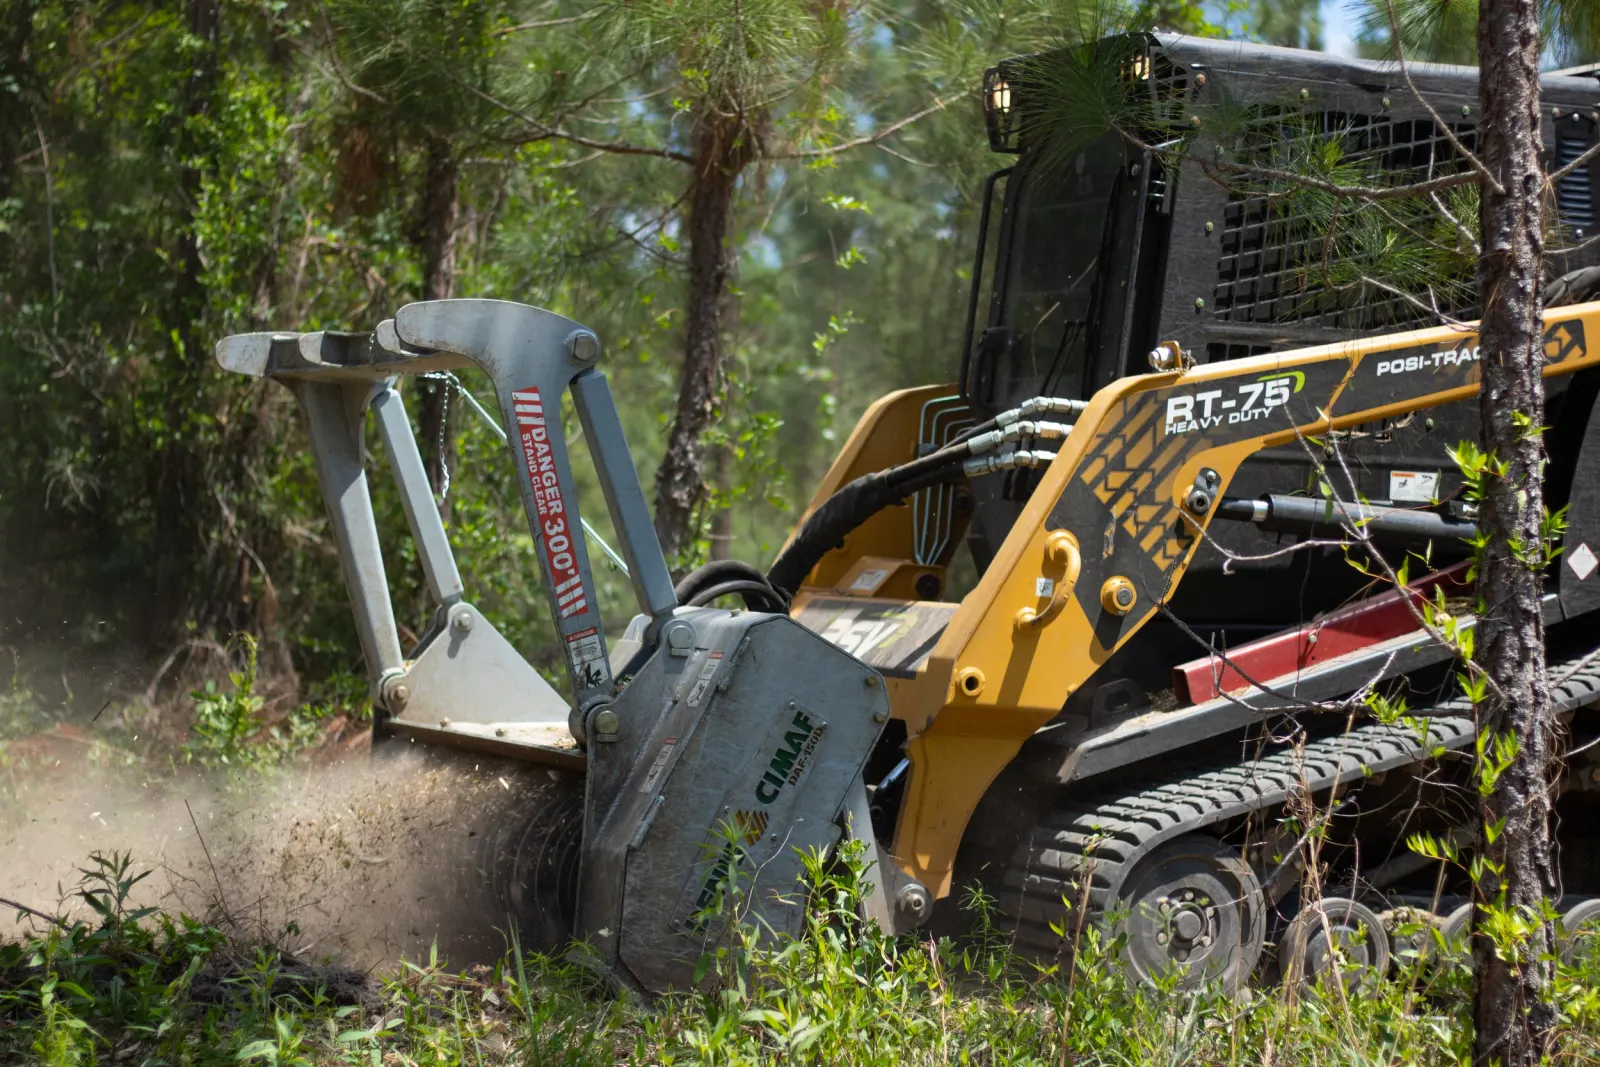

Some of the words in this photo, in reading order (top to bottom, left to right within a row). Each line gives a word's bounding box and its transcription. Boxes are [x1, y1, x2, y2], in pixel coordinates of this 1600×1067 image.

[1376, 346, 1481, 376] POSI-TRAC
[1164, 415, 1224, 436] HEAVY
[1228, 406, 1274, 424] DUTY
[1165, 378, 1290, 425] RT-75
[522, 432, 538, 473] STAND
[531, 475, 548, 516] CLEAR
[531, 426, 564, 516] DANGER
[755, 710, 814, 805] CIMAF
